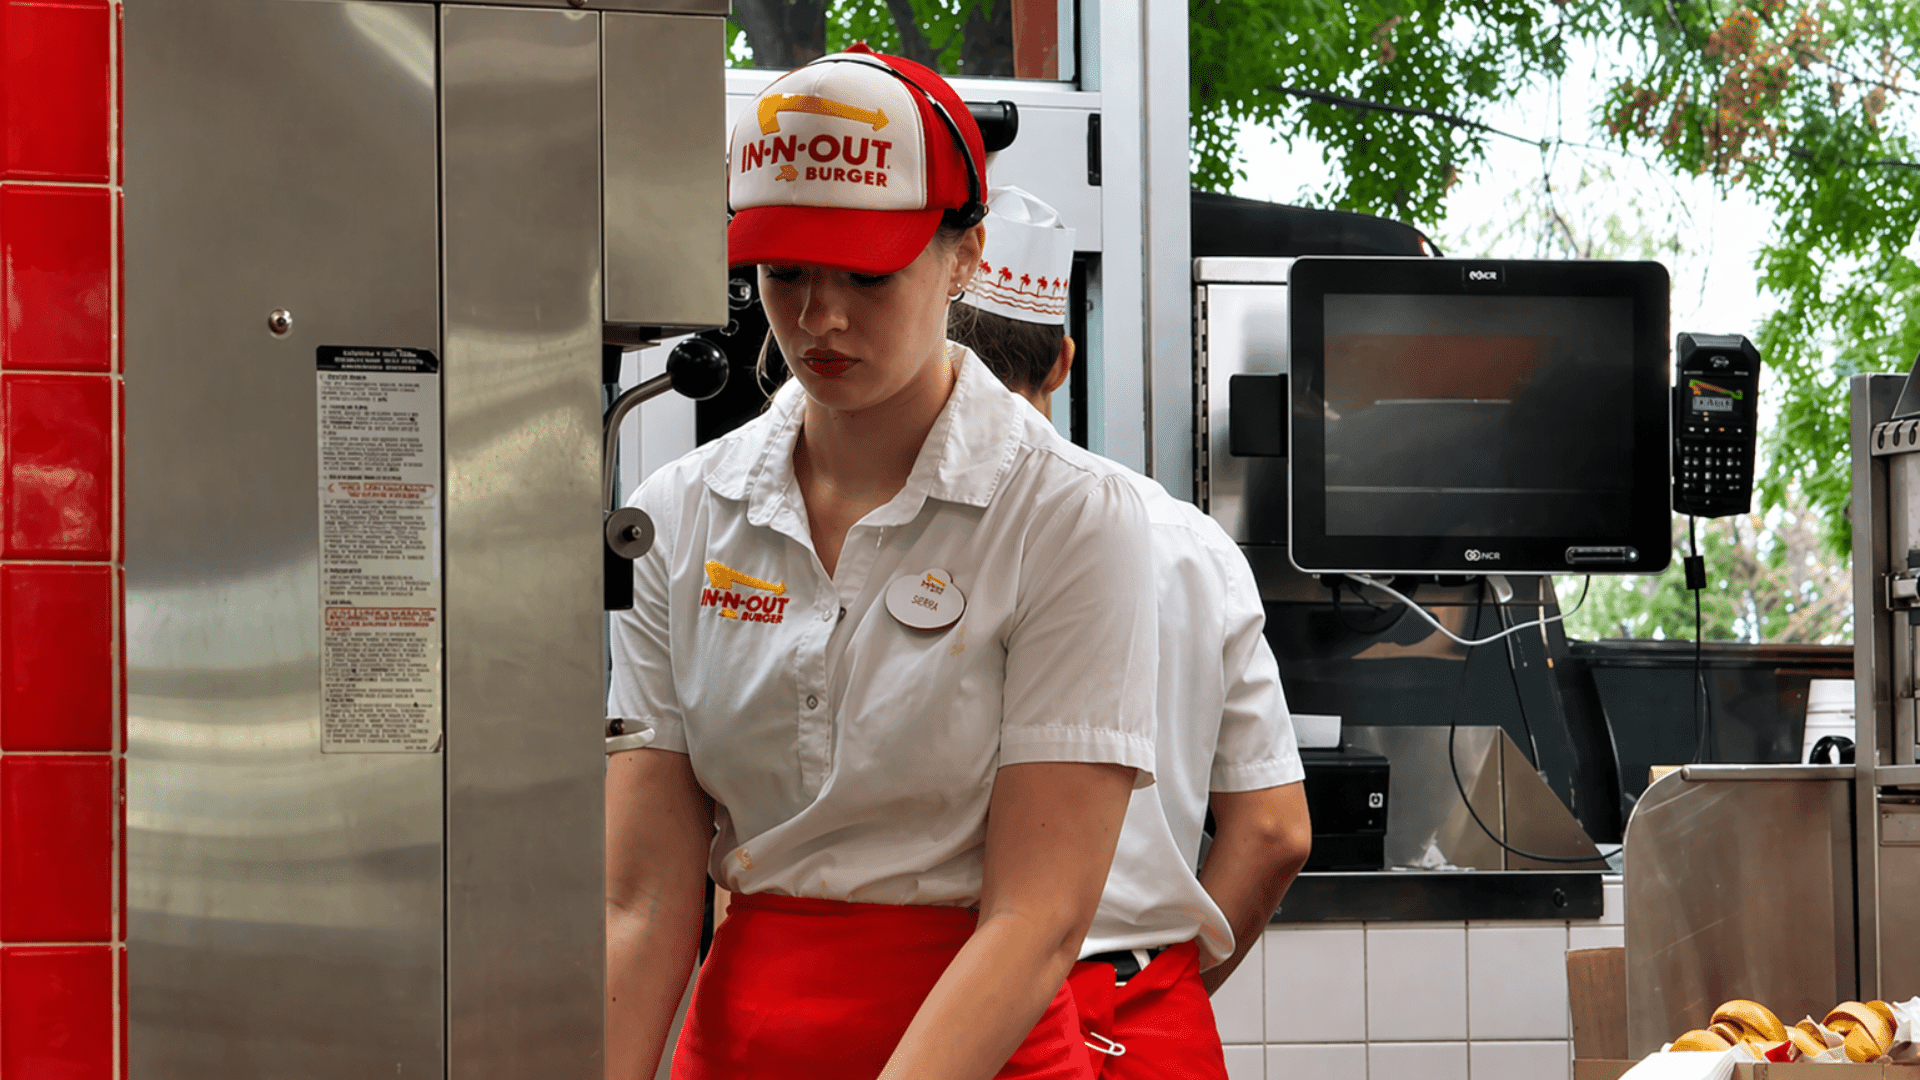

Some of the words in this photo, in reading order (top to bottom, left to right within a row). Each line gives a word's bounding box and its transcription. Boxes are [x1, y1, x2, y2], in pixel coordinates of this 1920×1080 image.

[805, 166, 888, 187] BURGER
[1481, 552, 1500, 560] NCR
[741, 611, 783, 624] BURGER
